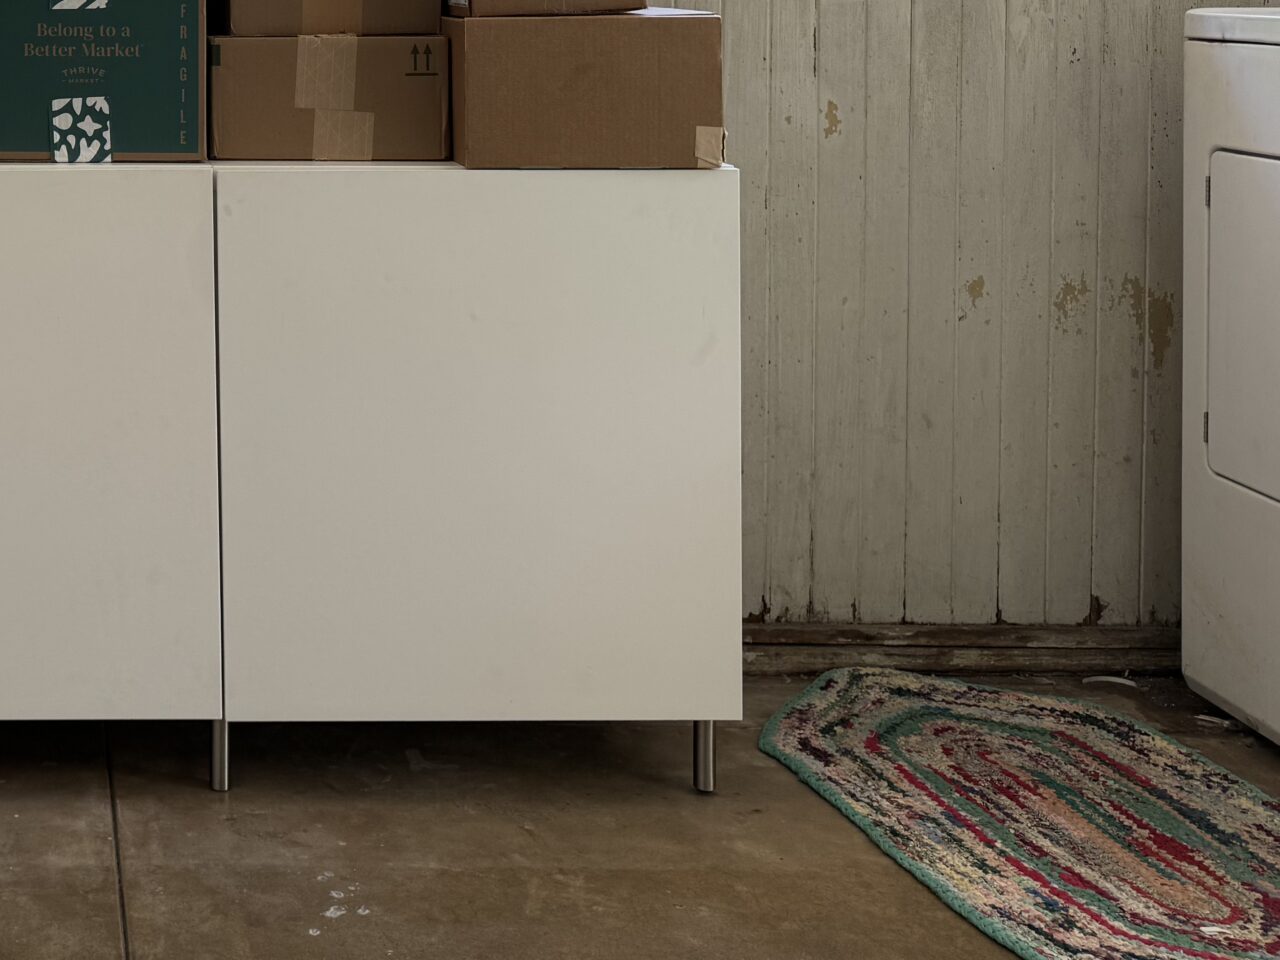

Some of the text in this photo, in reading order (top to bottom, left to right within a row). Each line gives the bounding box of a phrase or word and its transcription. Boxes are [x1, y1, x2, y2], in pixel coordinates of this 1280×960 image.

[36, 23, 131, 41] Belong to a
[23, 43, 77, 57] Better
[62, 66, 106, 77] THRIVE
[179, 3, 188, 144] FRAGILE
